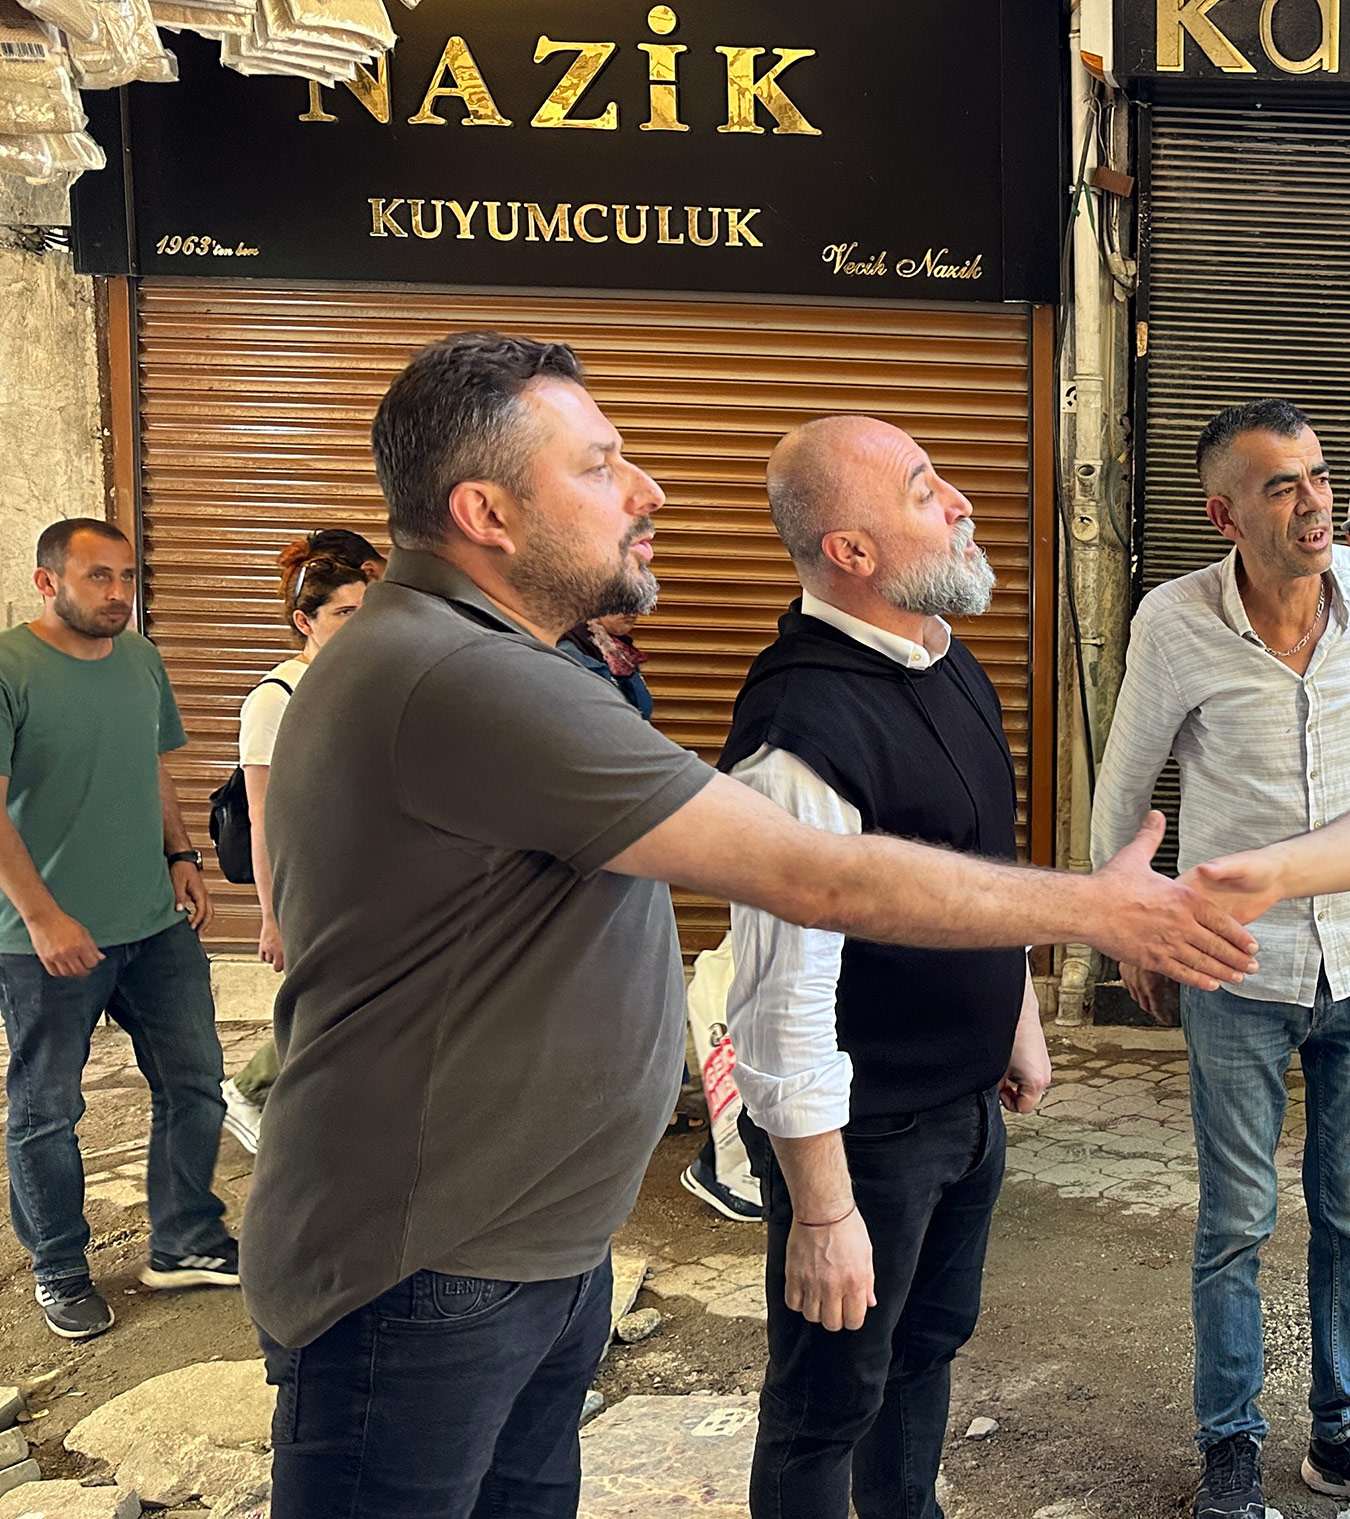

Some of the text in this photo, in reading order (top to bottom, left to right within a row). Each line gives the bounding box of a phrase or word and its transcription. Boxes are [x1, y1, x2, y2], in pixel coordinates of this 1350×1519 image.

[367, 197, 764, 247] KUYUMCULUK
[821, 241, 983, 280] Vecih Nazik
